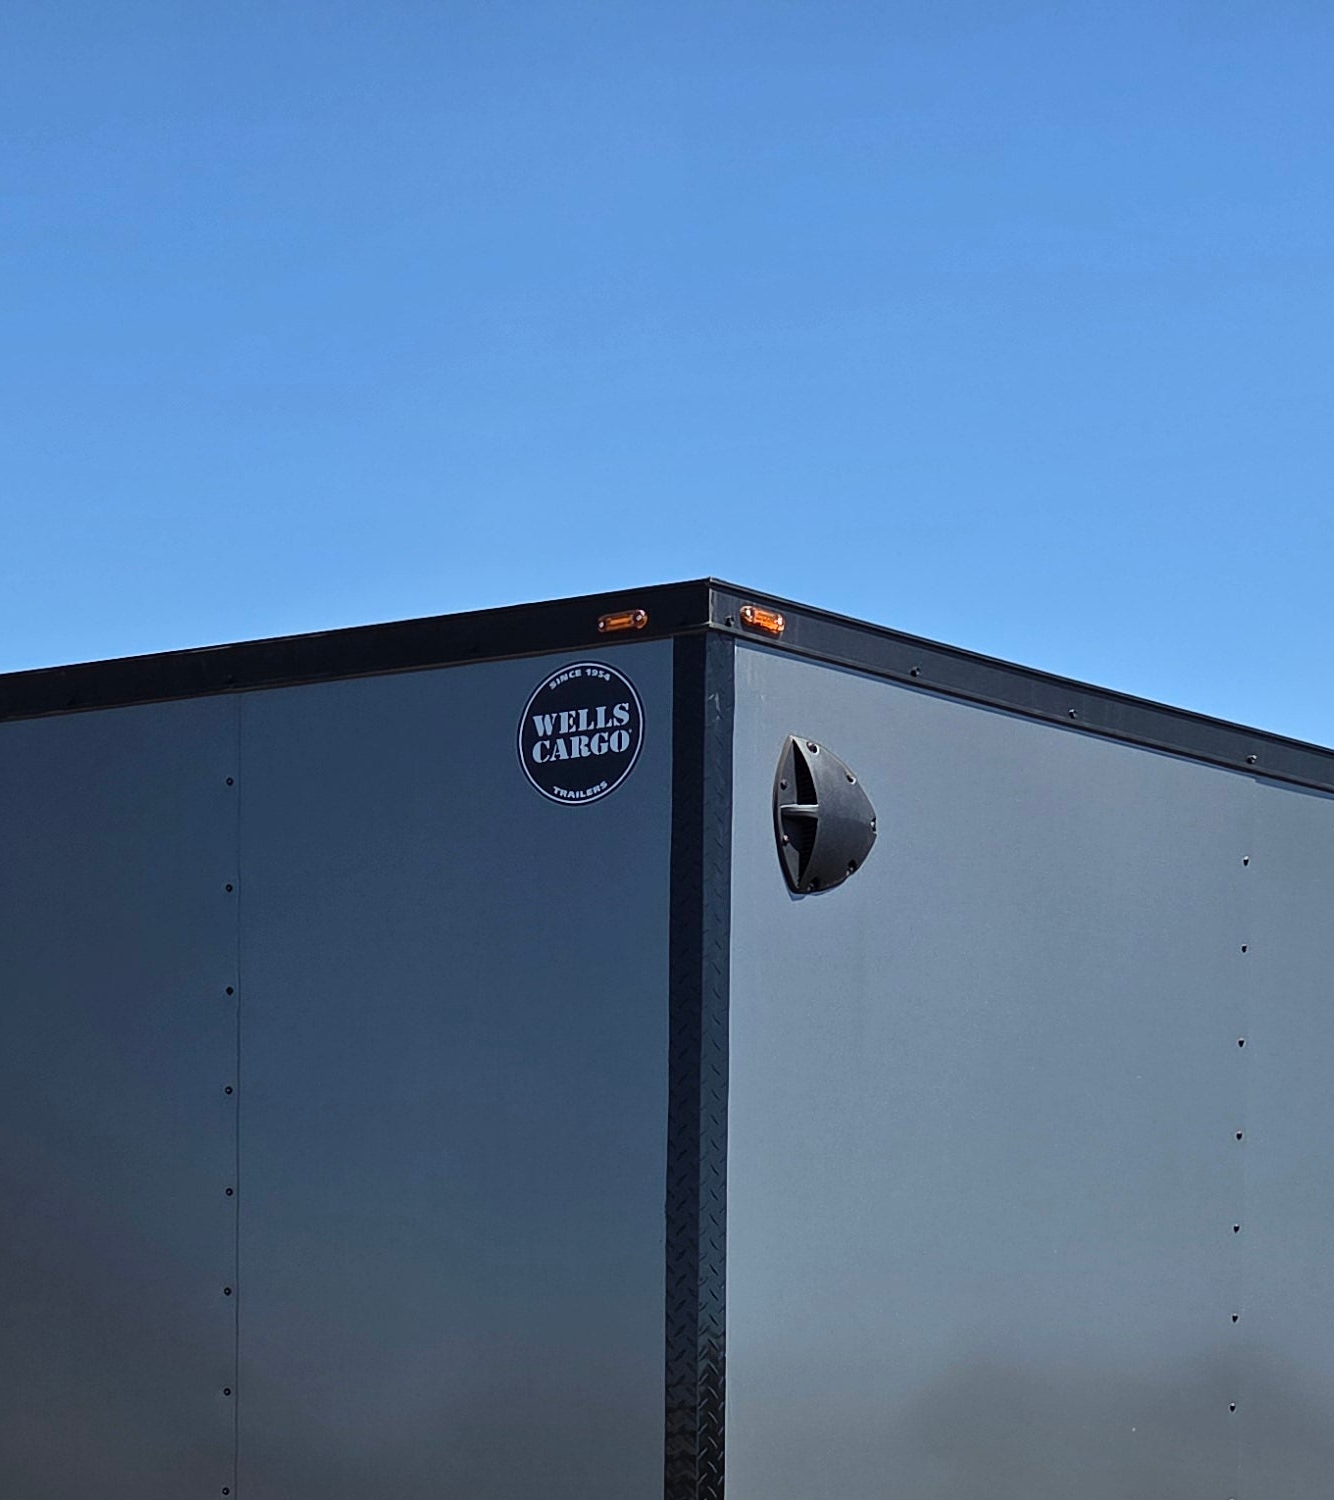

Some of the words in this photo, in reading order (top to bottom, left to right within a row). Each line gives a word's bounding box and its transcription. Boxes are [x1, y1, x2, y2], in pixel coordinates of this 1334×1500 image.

[549, 669, 582, 690] SINCE
[586, 668, 611, 682] 1954
[532, 702, 630, 737] WELLS
[532, 729, 630, 763] CARGO
[553, 781, 608, 799] TRAILERS
